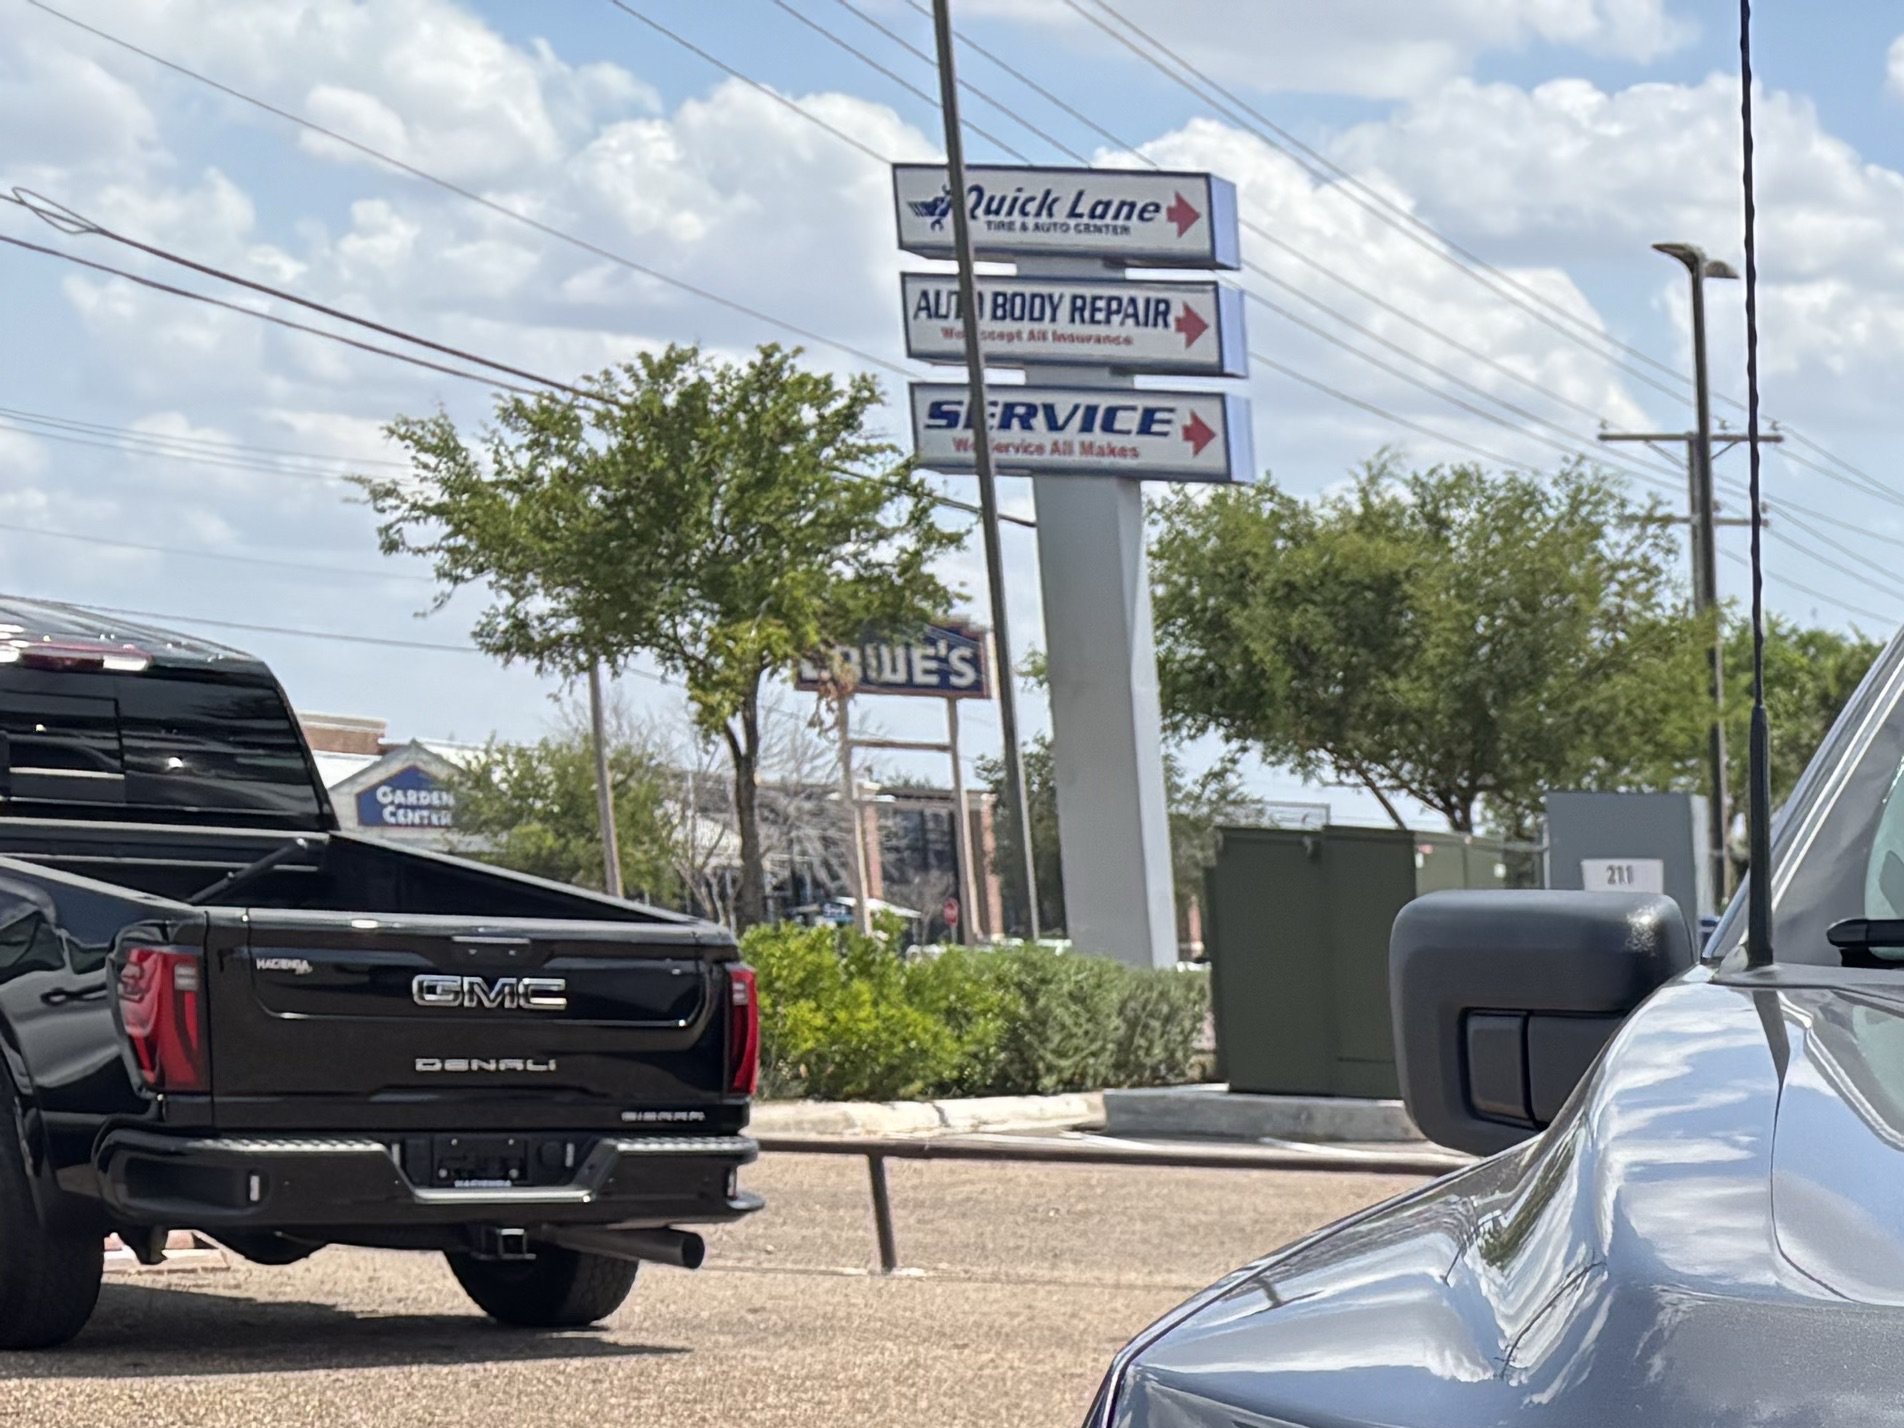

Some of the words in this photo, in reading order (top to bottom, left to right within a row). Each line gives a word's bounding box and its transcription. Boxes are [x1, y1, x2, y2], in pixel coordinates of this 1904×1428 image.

[967, 183, 1060, 220] Quick
[1066, 189, 1162, 222] Lane
[986, 220, 1015, 232] TIRE
[1020, 222, 1029, 233] &
[1033, 222, 1070, 234] AUTO
[1074, 223, 1131, 236] CENTER
[990, 291, 1064, 323] BODY
[1069, 295, 1171, 329] REPAIR
[979, 329, 1023, 344] ccept
[1027, 329, 1048, 343] All
[1052, 330, 1134, 347] Insurance
[924, 400, 1176, 437] SERVICE
[1050, 439, 1075, 457] All
[1079, 440, 1140, 459] Makes
[376, 785, 456, 807] GARDEN
[412, 974, 568, 1010] GMC
[415, 1058, 556, 1071] DENALI
